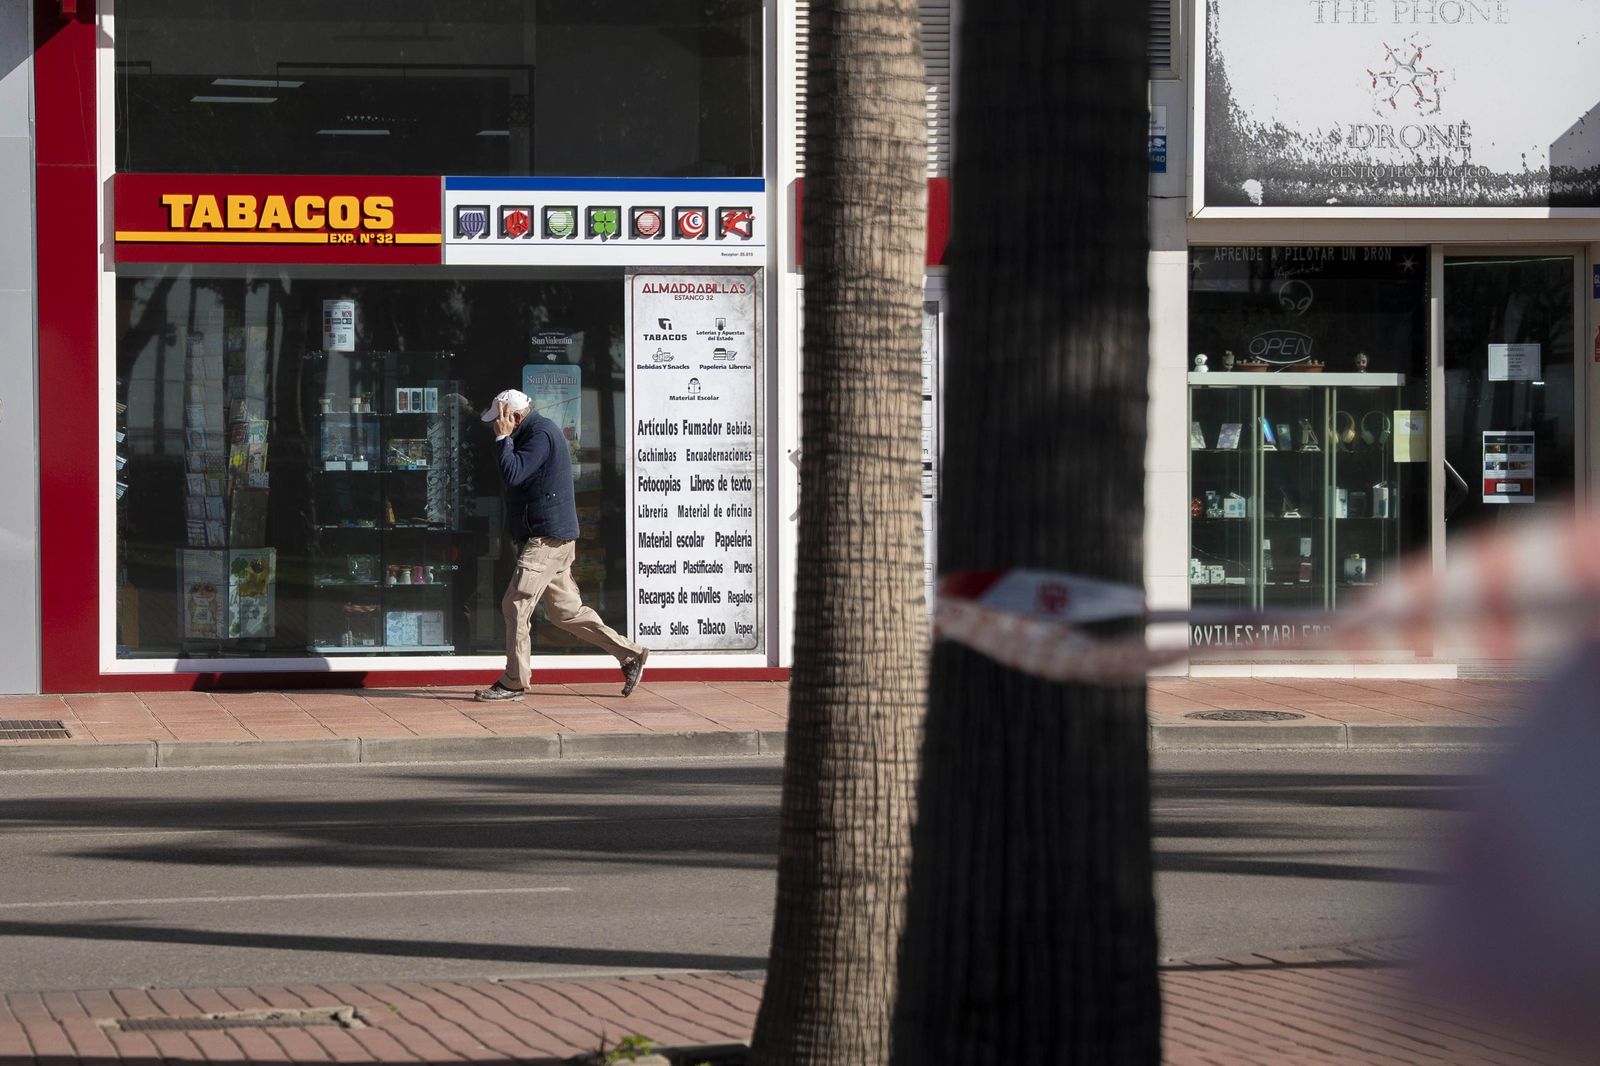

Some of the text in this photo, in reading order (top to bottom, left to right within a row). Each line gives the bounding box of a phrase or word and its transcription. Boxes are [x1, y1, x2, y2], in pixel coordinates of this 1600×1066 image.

[1311, 0, 1511, 25] THE PHONE
[1348, 123, 1471, 150] DRONE
[1330, 166, 1385, 178] CENTRO
[162, 194, 394, 229] TABACOS
[329, 233, 357, 244] EXP.
[1214, 247, 1392, 261] APRENDE A PILOTAR UN DRON
[641, 283, 746, 294] ALMADRABILLAS
[1249, 337, 1313, 355] OPEN
[638, 418, 752, 435] Artículos Fumador Bebida
[638, 447, 752, 462] Cachimbas Encuadernaciones
[638, 474, 752, 496] Fotocopias Libros de texto
[638, 504, 752, 518] Librería Material de oficina
[638, 529, 752, 552] Material escolar Papelería
[638, 560, 753, 578] Paysafecard Plastificados Puros
[639, 586, 753, 609] Recargas de móviles Regalos
[639, 618, 753, 638] Snacks Sellos Tabaco Vaper
